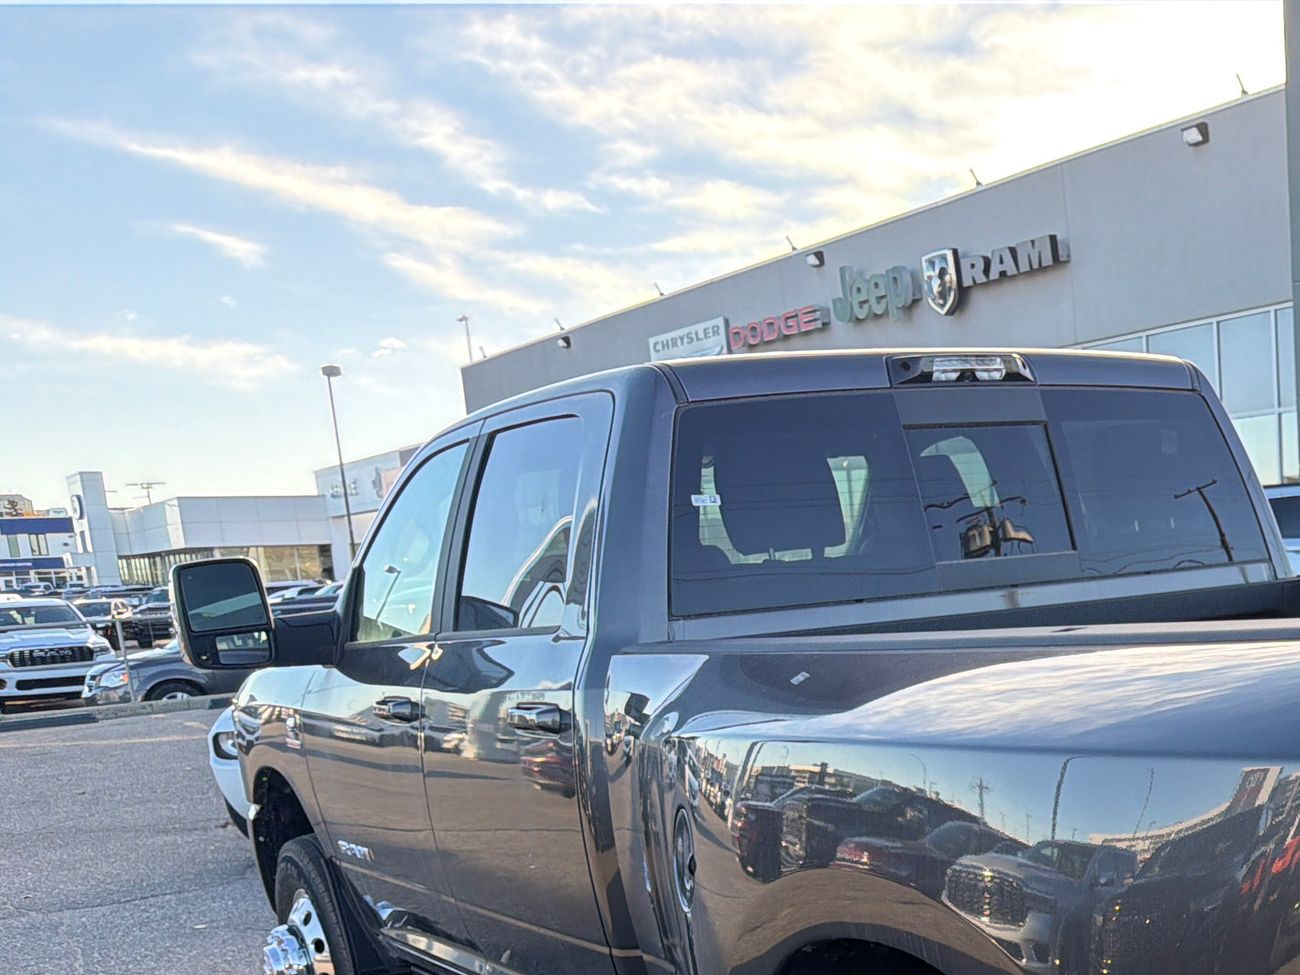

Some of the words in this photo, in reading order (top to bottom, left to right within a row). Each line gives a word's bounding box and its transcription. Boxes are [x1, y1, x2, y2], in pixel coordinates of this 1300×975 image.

[960, 233, 1057, 288] RAM
[832, 264, 913, 323] Jeep
[653, 324, 721, 353] CHRYSLER
[728, 304, 819, 349] DODGE
